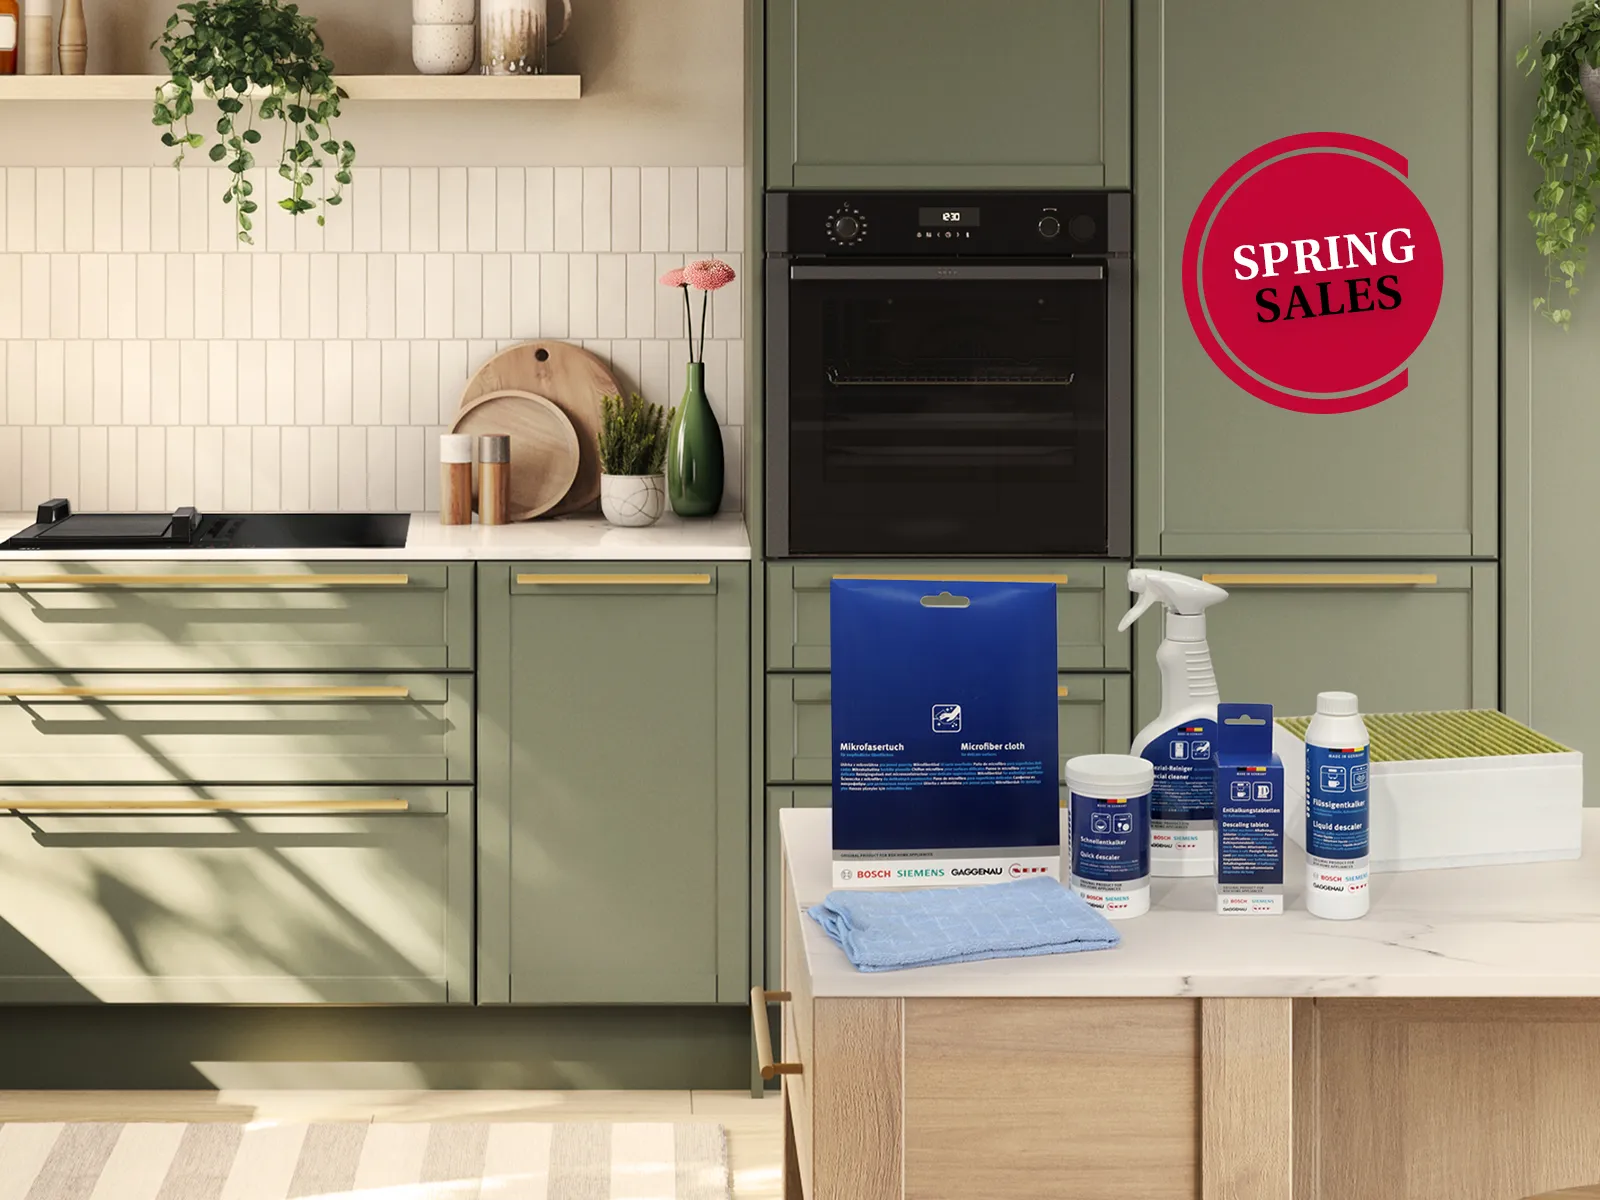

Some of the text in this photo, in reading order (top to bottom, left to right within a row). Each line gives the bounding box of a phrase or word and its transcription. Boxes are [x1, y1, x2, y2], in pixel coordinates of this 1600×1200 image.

[840, 743, 904, 751] Mikrofasertuch
[960, 742, 1025, 751] Microfiber cloth
[1312, 798, 1366, 809] Flüssigentkalker
[1312, 820, 1363, 831] Liquid descaler
[1080, 836, 1127, 846] Schnellentkalker
[1080, 851, 1121, 861] Quick descaler
[857, 870, 891, 878] BOSCH
[897, 869, 945, 877] SIEMENS
[951, 867, 1003, 876] GAGGENAU
[1321, 874, 1342, 882] BOSCH
